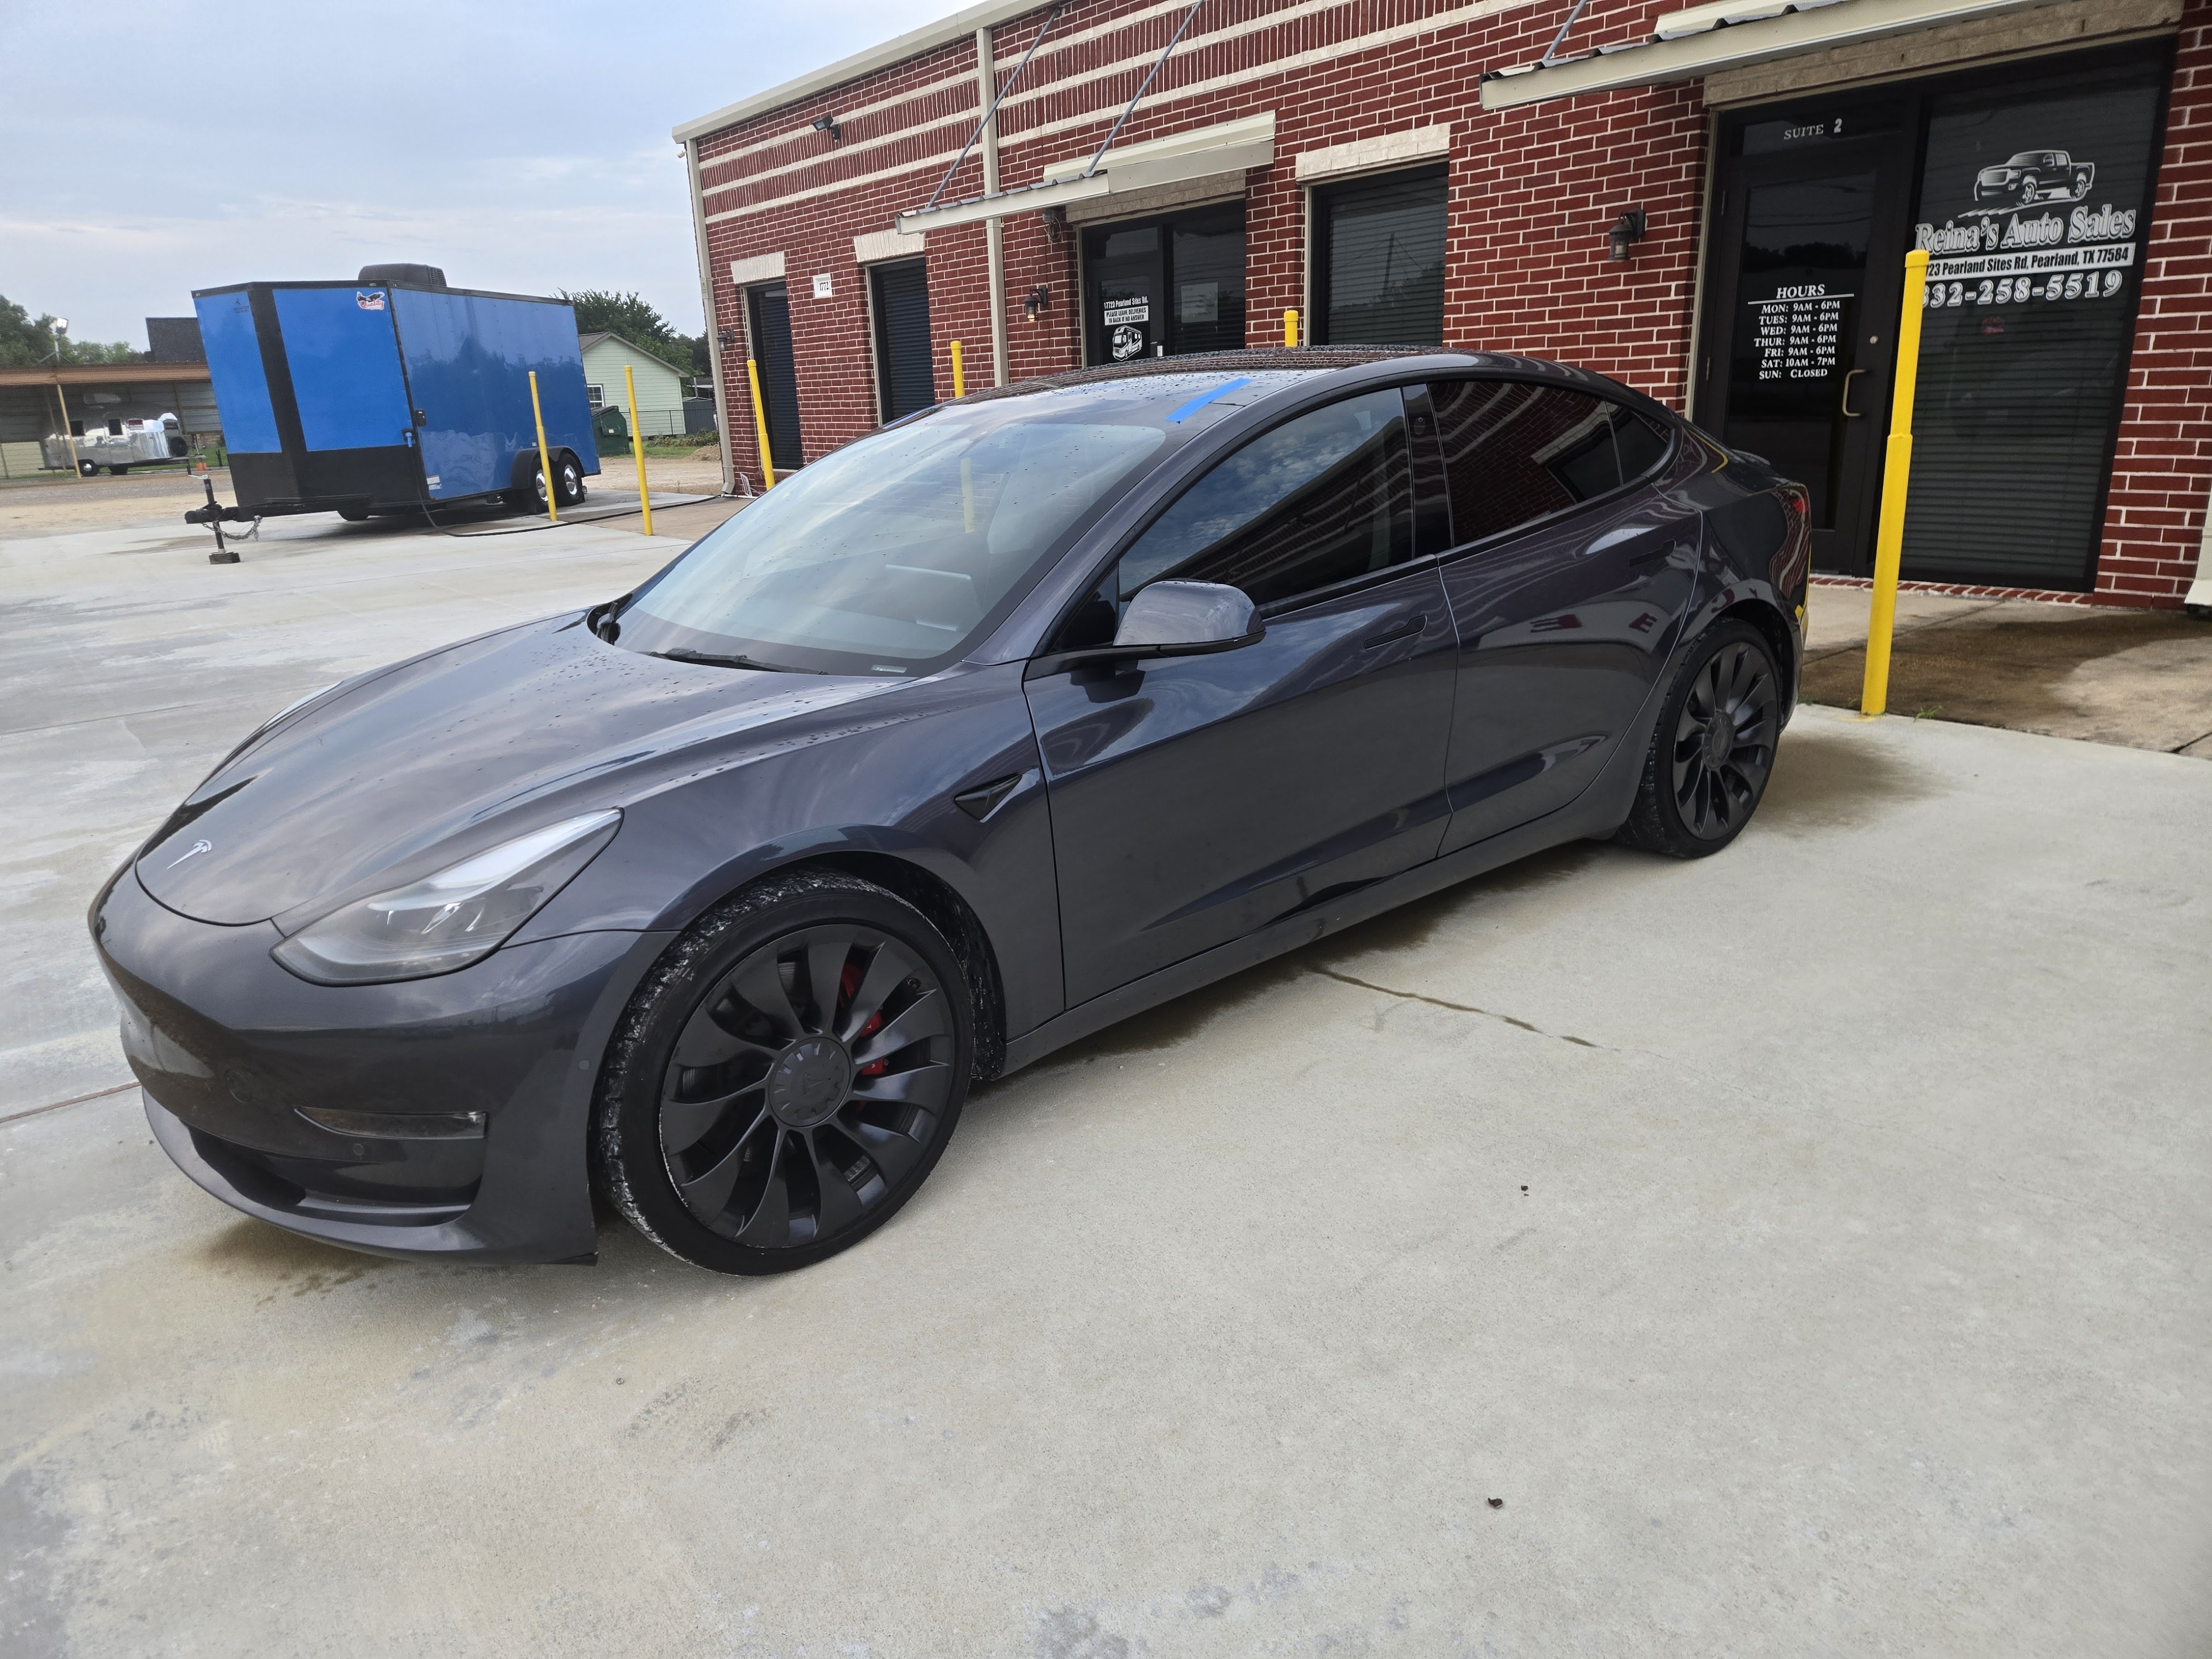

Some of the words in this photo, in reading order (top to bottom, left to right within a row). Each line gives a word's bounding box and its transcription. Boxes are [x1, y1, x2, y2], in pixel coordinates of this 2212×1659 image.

[1784, 124, 1824, 140] SUITE
[1834, 118, 1842, 133] 2
[1915, 216, 2000, 255] Reina's
[2000, 212, 2064, 249] Auto
[2068, 204, 2136, 243] Sales
[1942, 258, 1985, 275] Pearland
[1987, 258, 2012, 272] Sites
[2014, 255, 2028, 269] Rd,
[2031, 251, 2079, 268] Pearland,
[2083, 249, 2095, 264] TX
[2097, 247, 2129, 263] 77584
[820, 281, 831, 291] 1772
[1776, 284, 1825, 299] HOURS
[1115, 298, 1131, 307] Pearland
[1761, 304, 1788, 314] MON:
[1793, 302, 1812, 311] 9AM
[1821, 300, 1840, 310] 6PM
[1759, 315, 1787, 325] TUES:
[1792, 314, 1811, 322] 9AM
[1819, 312, 1839, 321] 6PM
[1761, 326, 1786, 336] WED:
[1791, 325, 1810, 334] 9AM
[1818, 323, 1837, 332] 6PM
[1754, 337, 1785, 347] THUR:
[1790, 336, 1808, 345] 9AM
[1817, 335, 1836, 344] 6PM
[1764, 348, 1784, 357] FRI:
[1788, 347, 1807, 356] 9AM
[1816, 346, 1835, 355] 6PM
[1761, 359, 1783, 368] SAT:
[1785, 358, 1808, 367] 10AM
[1817, 357, 1835, 366] 7PM
[1759, 370, 1782, 379] SUN:
[1790, 369, 1828, 378] CLOSED
